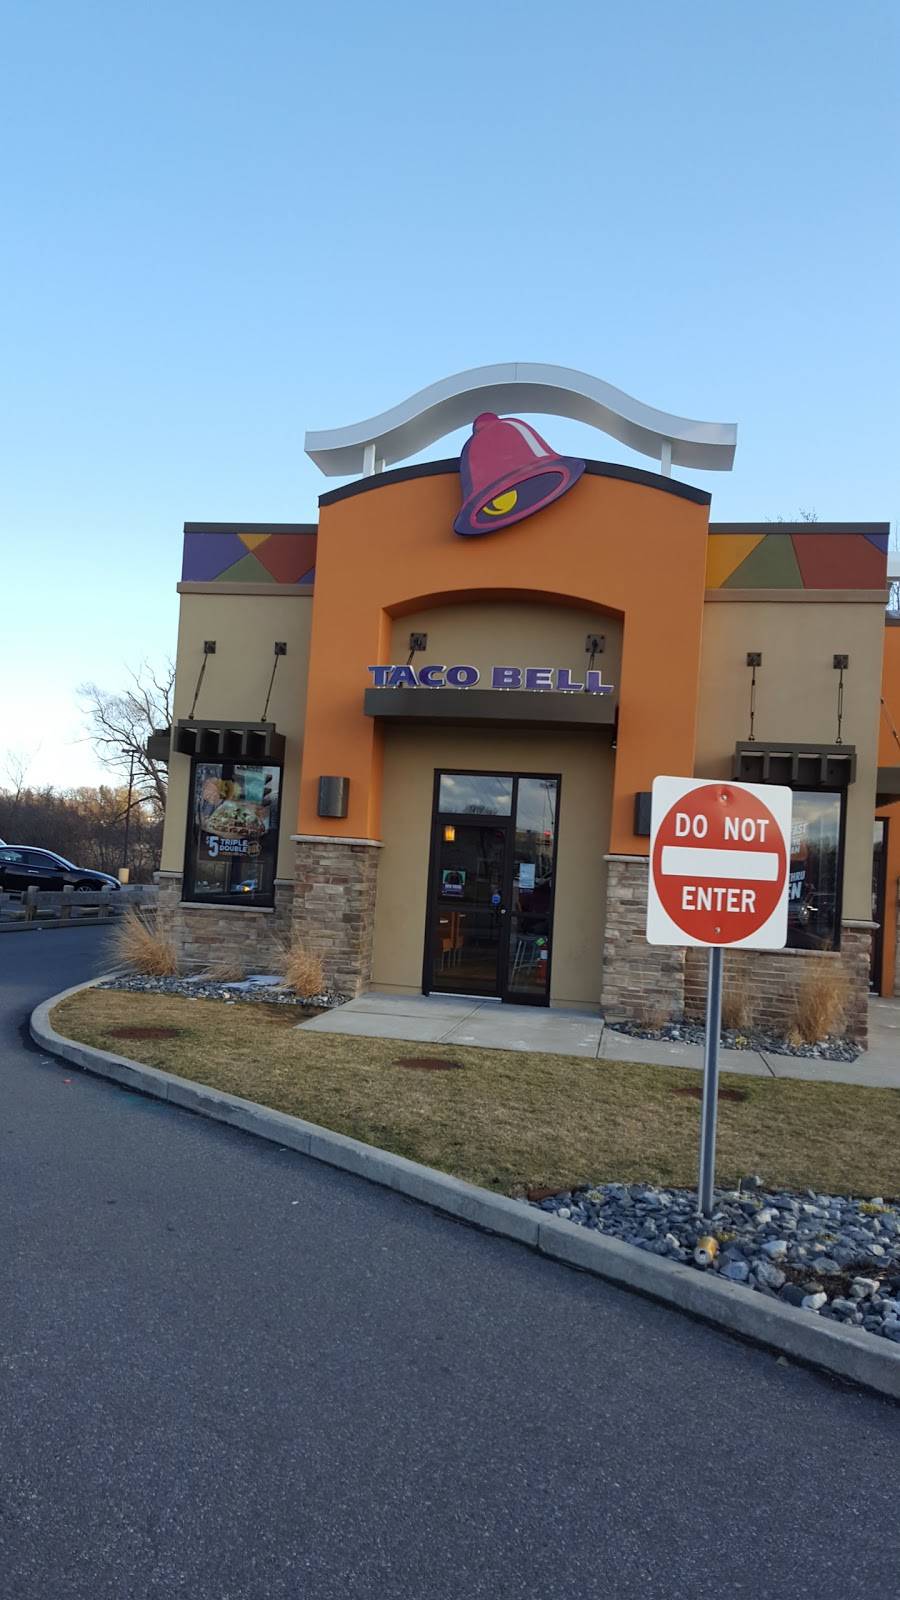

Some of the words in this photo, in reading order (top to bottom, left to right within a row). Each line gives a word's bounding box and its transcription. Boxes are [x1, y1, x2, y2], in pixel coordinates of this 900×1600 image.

[368, 665, 480, 688] TACO
[492, 666, 614, 694] BELL
[675, 812, 708, 838] DO
[724, 816, 769, 842] NOT
[220, 839, 248, 847] TRIPLE
[681, 886, 756, 913] ENTER
